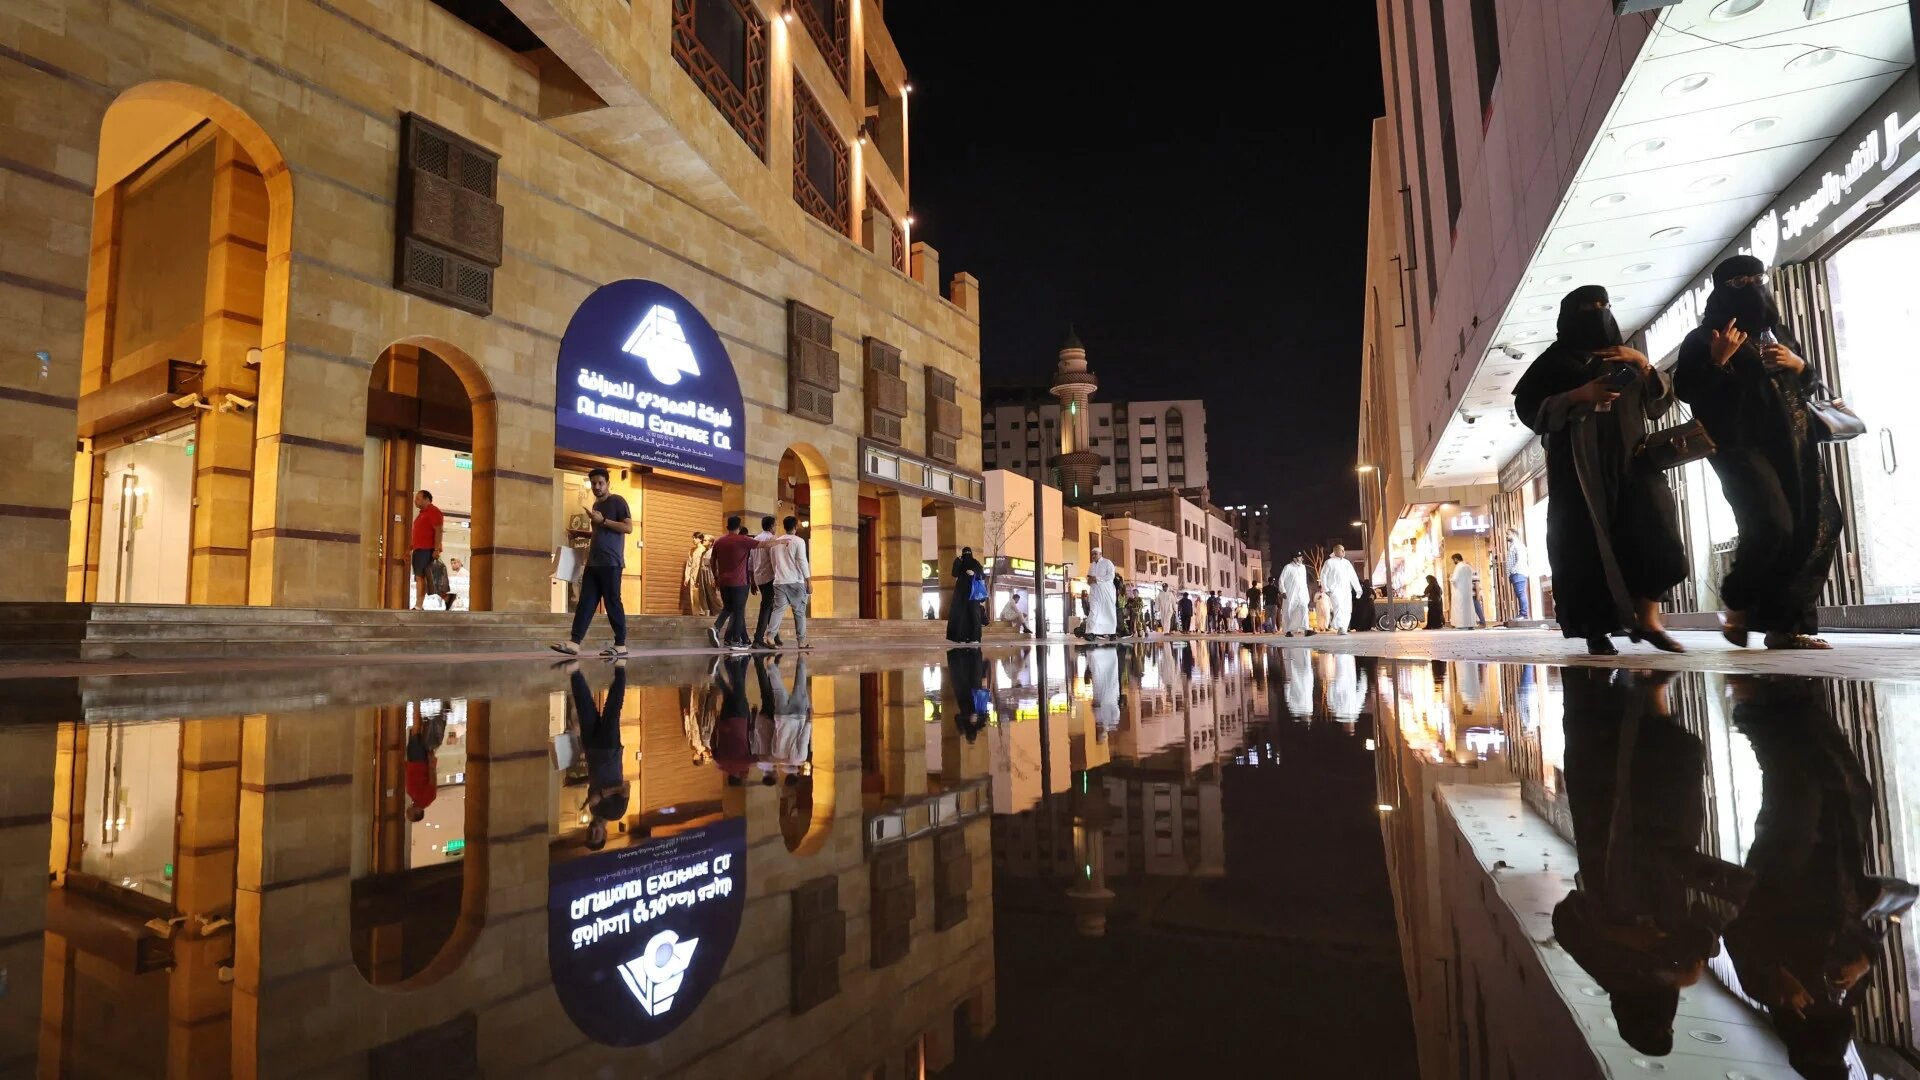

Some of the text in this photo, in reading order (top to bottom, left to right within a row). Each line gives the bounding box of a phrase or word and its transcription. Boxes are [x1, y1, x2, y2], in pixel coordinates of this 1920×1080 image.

[577, 368, 733, 428] شركة العمودي للصرافة
[648, 415, 709, 446] EXCHANGE
[670, 443, 692, 453] محمد
